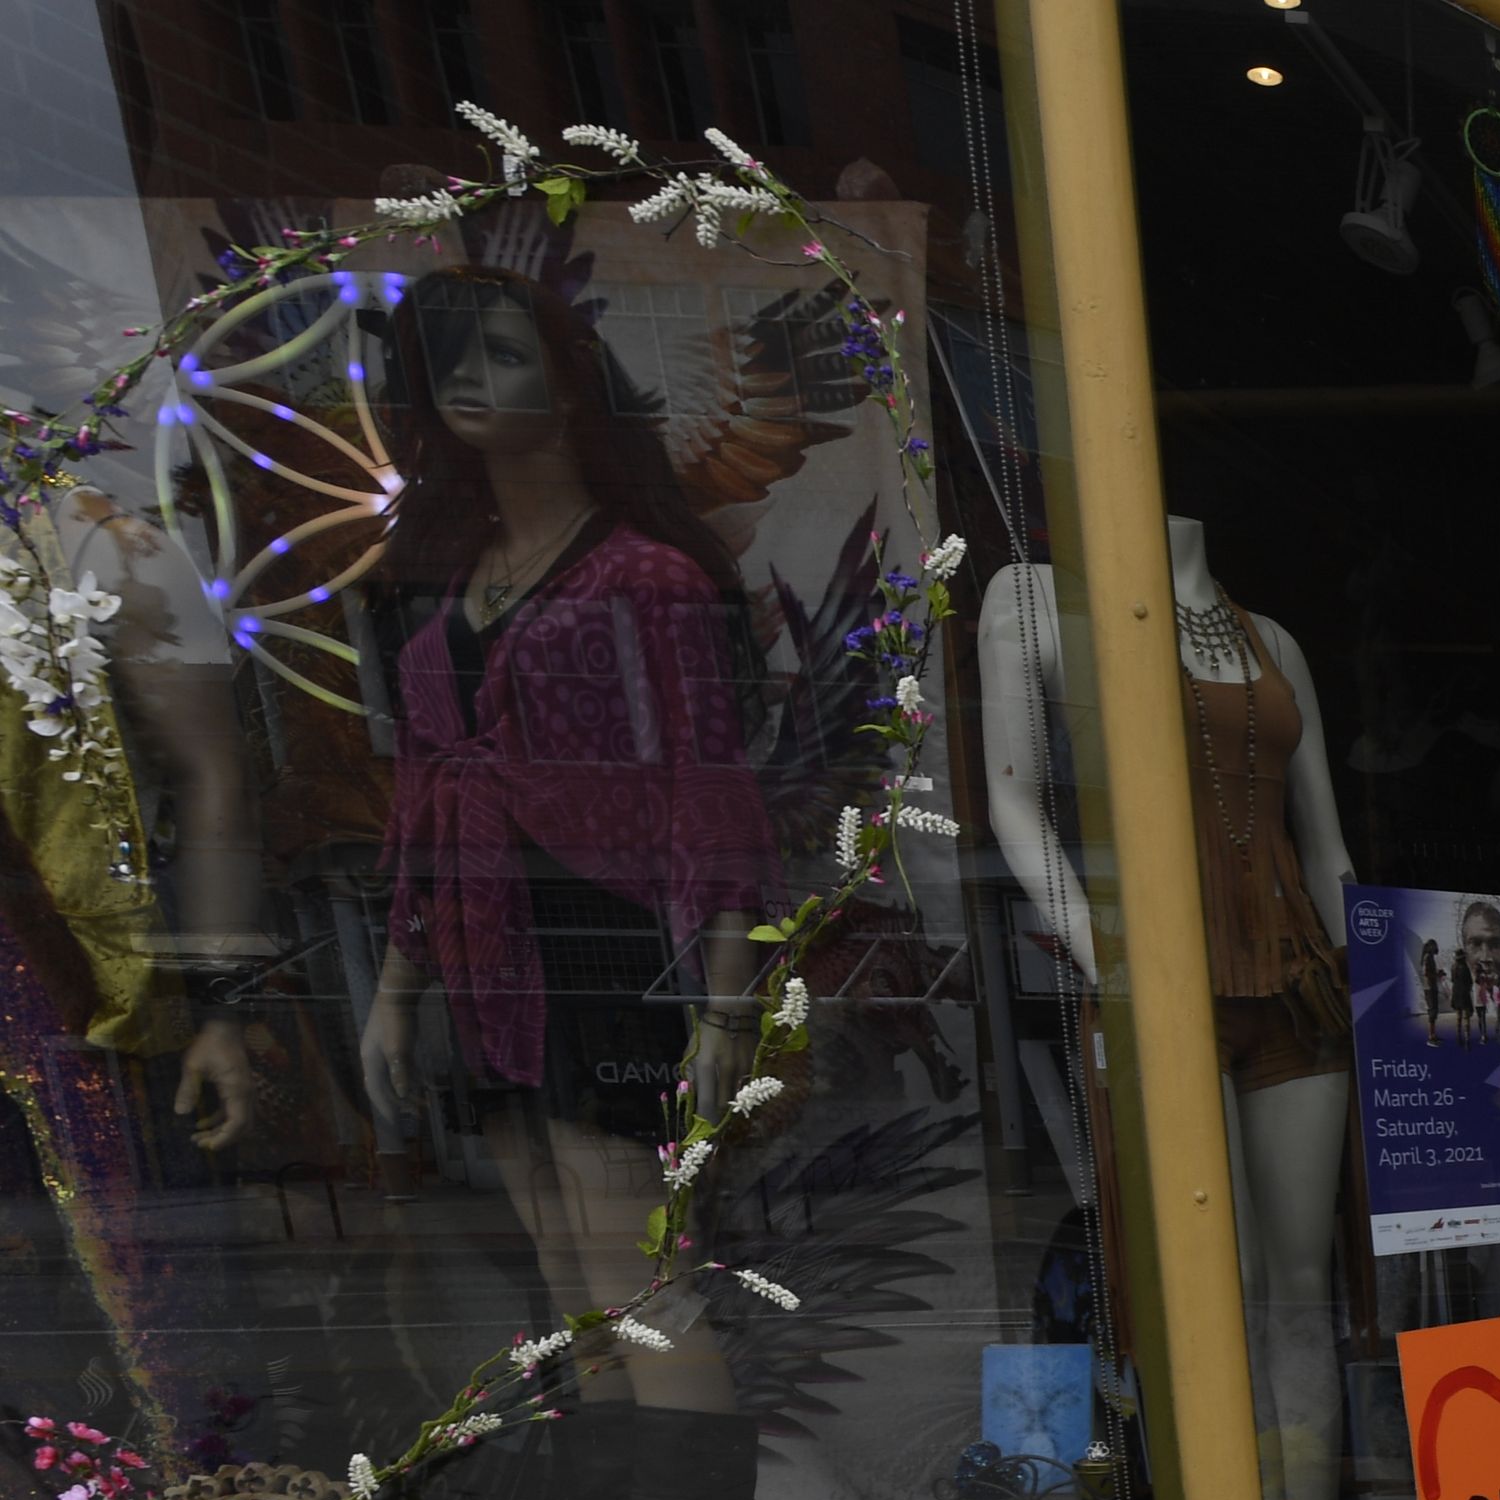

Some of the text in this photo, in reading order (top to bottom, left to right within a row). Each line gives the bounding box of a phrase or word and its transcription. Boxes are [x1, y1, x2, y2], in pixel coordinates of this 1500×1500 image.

[1357, 907, 1395, 919] BOULDER
[1358, 918, 1380, 929] ARTS
[1359, 928, 1384, 939] WEEK
[1371, 1058, 1432, 1080] Friday,
[1374, 1089, 1429, 1108] March
[1433, 1087, 1454, 1106] 26
[1376, 1118, 1459, 1139] Saturday,
[1379, 1147, 1422, 1170] April
[1445, 1147, 1485, 1163] 2021
